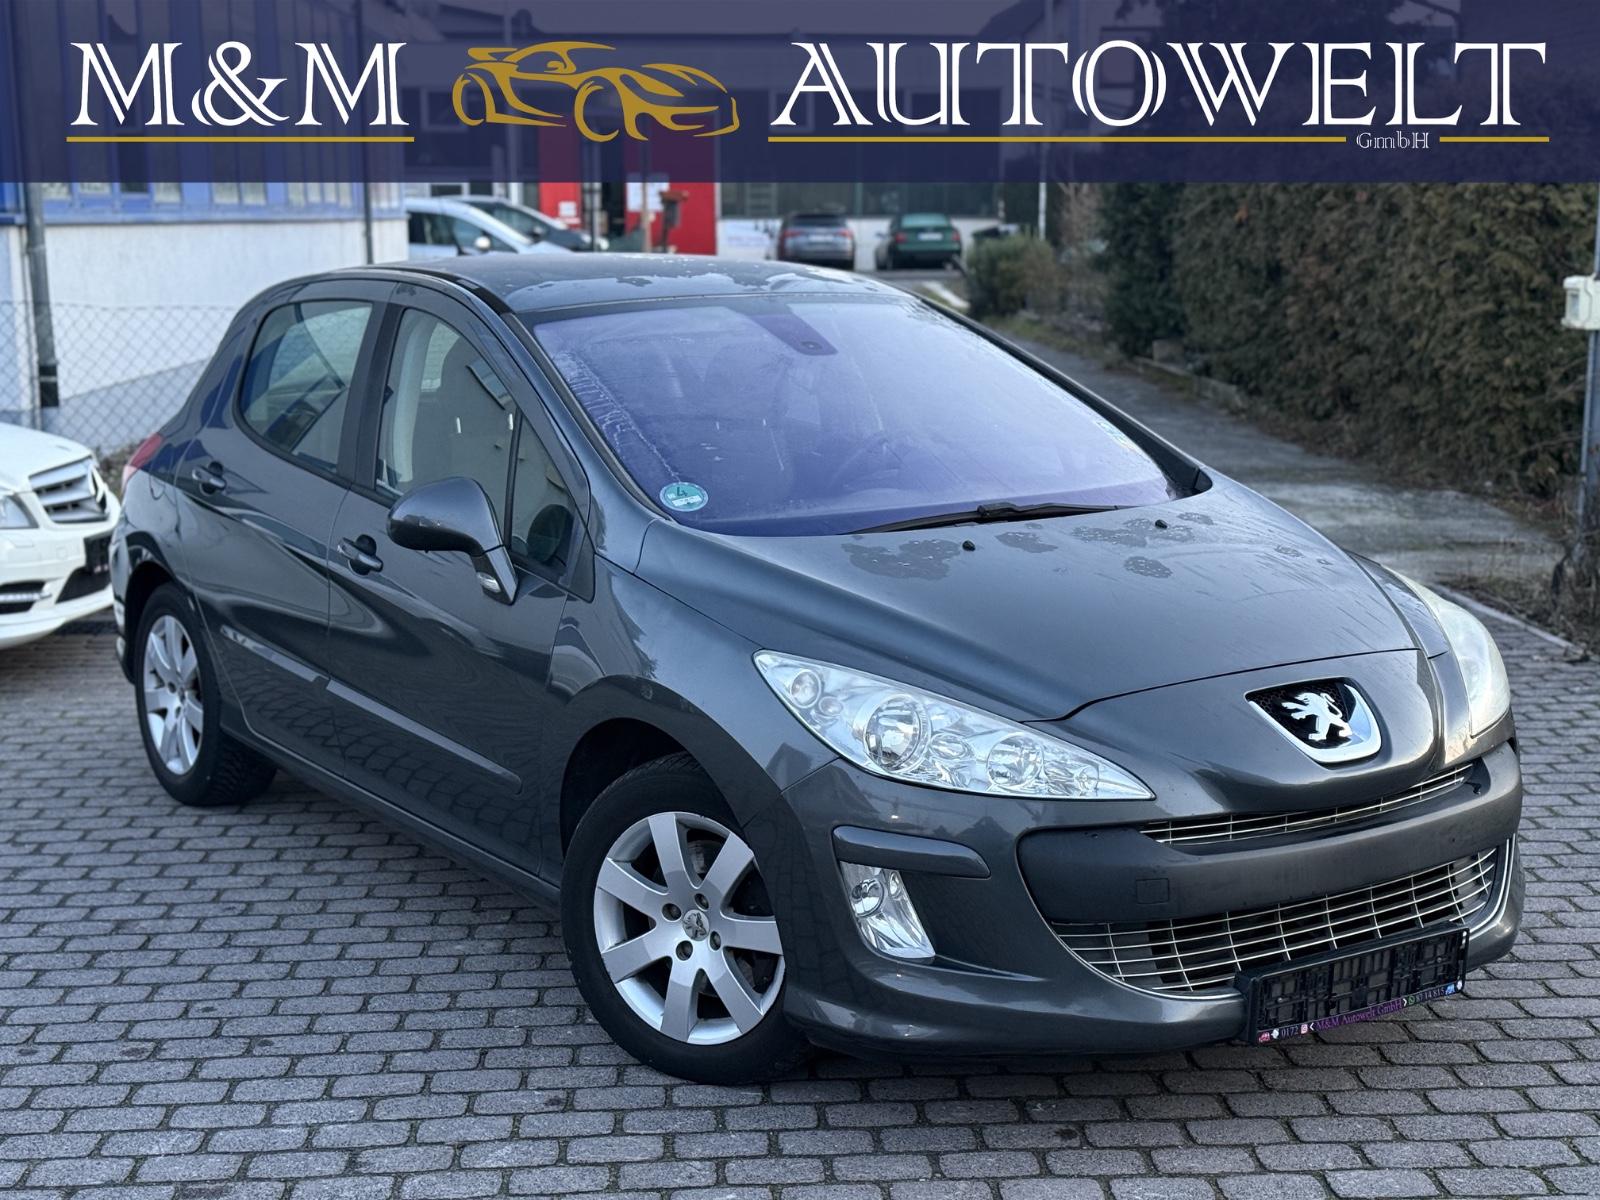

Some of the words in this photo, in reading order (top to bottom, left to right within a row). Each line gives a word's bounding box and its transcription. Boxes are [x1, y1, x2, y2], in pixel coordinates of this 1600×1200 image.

[1281, 1026, 1299, 1038] 0172
[1341, 1007, 1375, 1025] Autowelt
[1377, 1000, 1402, 1015] GmbH
